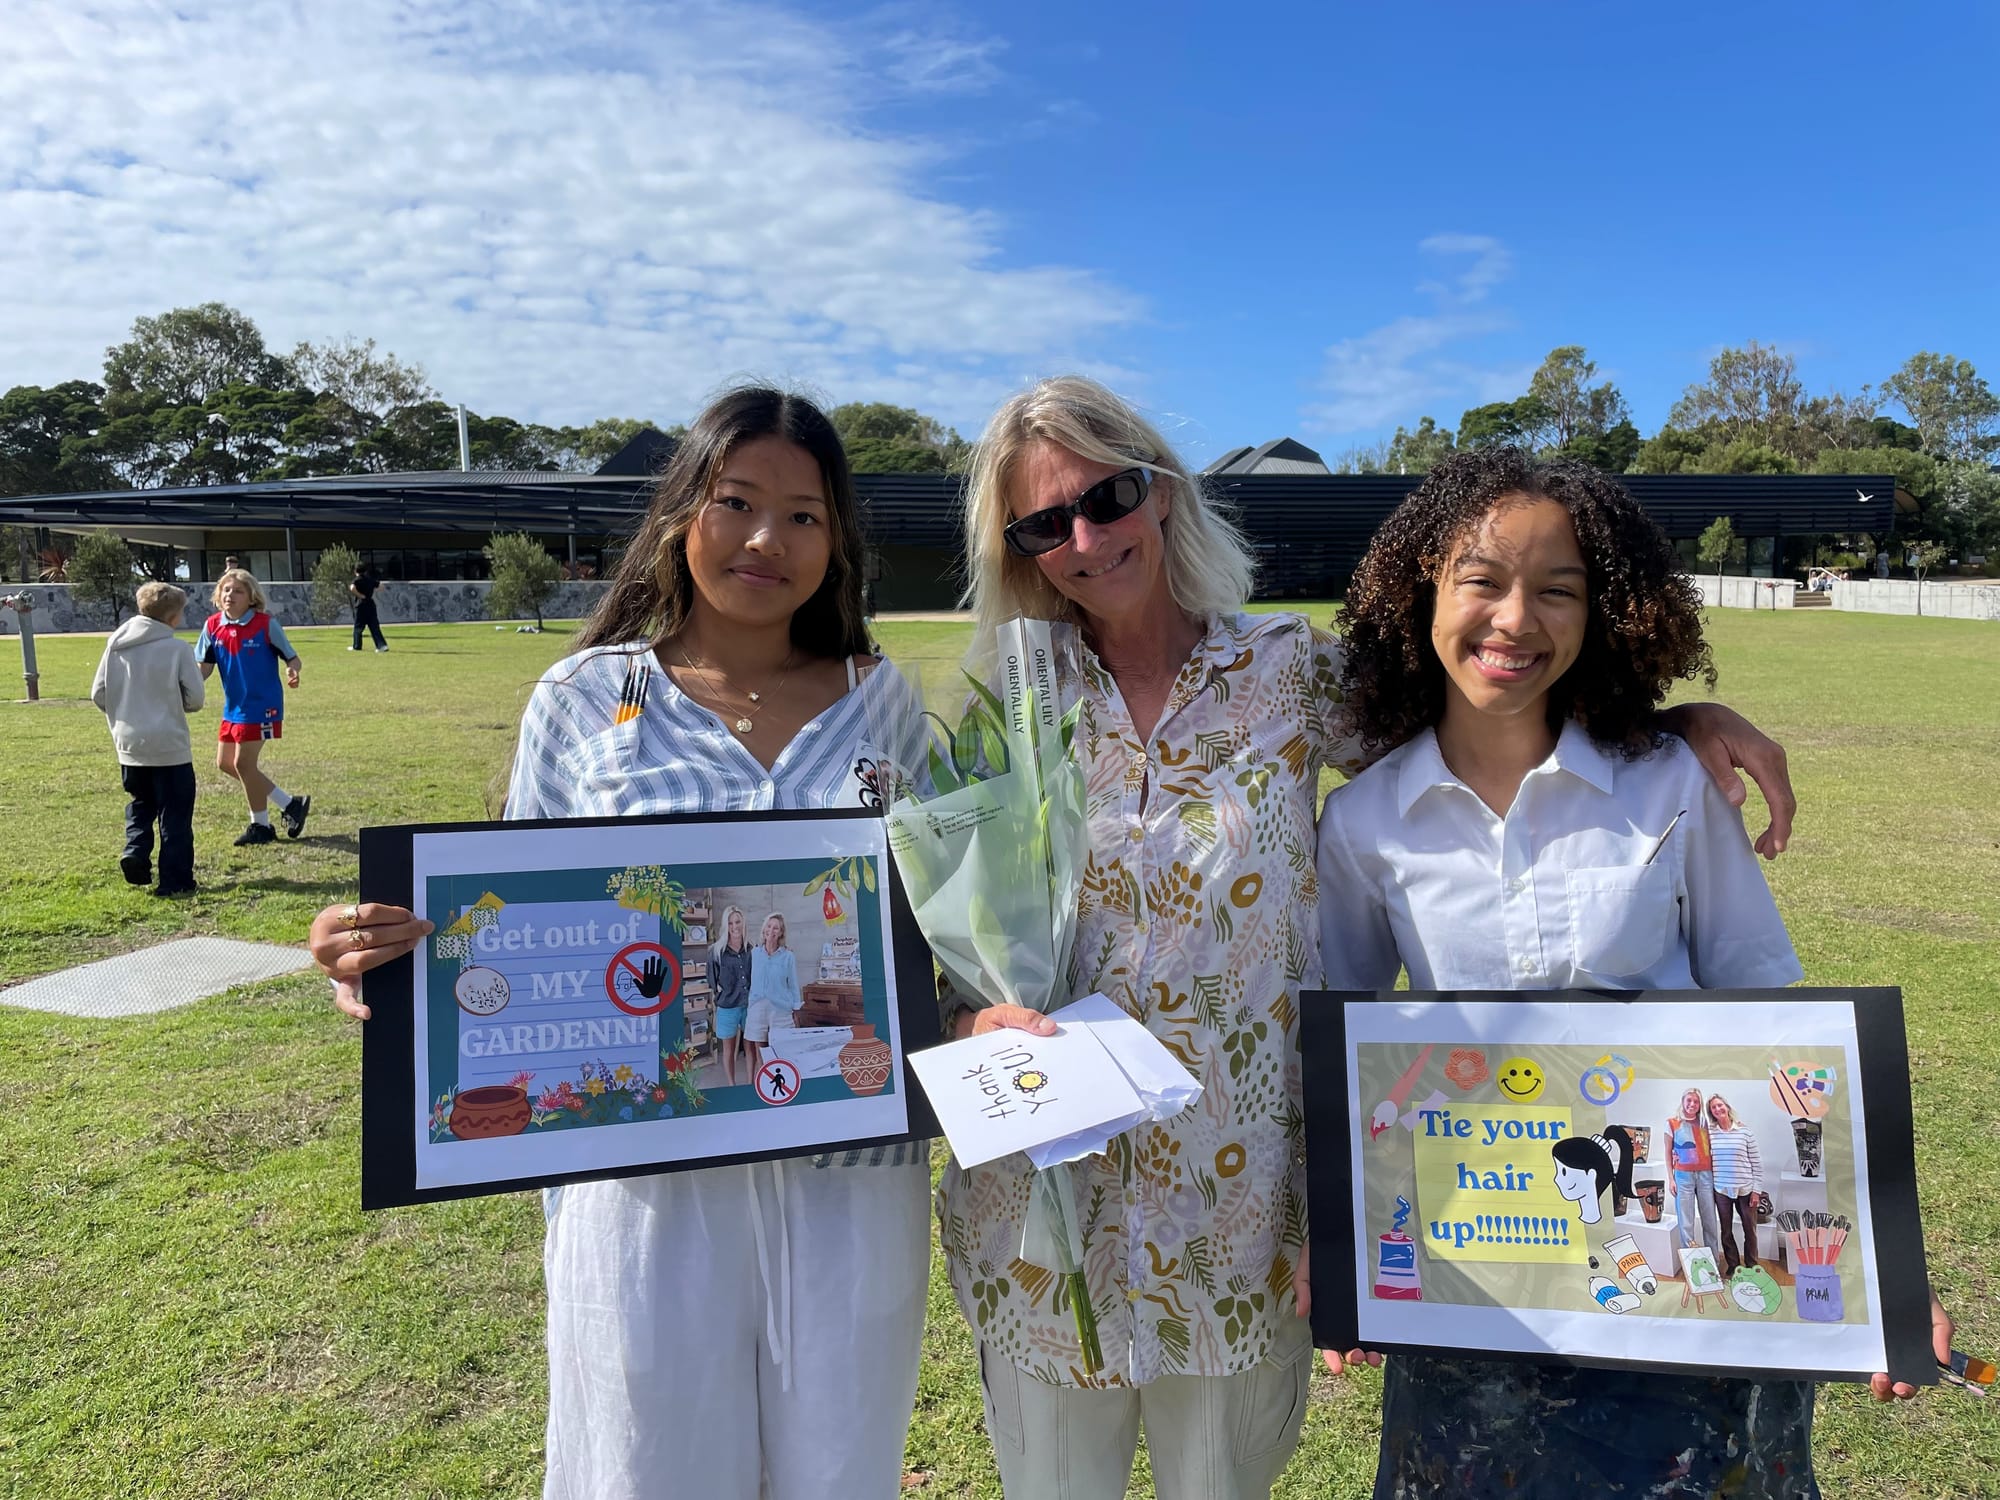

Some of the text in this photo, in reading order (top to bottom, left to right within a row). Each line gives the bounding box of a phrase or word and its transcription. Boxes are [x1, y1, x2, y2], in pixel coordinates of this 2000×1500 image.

[1007, 656, 1025, 734] ORIENTAL LILY
[1034, 648, 1053, 727] ORIENTAL LILY
[476, 912, 642, 952] Get out of
[530, 970, 591, 1000] MY
[459, 1016, 659, 1058] GARDENN!!
[1419, 1110, 1566, 1146] Tie your
[1456, 1162, 1534, 1191] hair
[1430, 1214, 1570, 1248] up!!!!!!!!!!
[1620, 1254, 1646, 1269] PAINT
